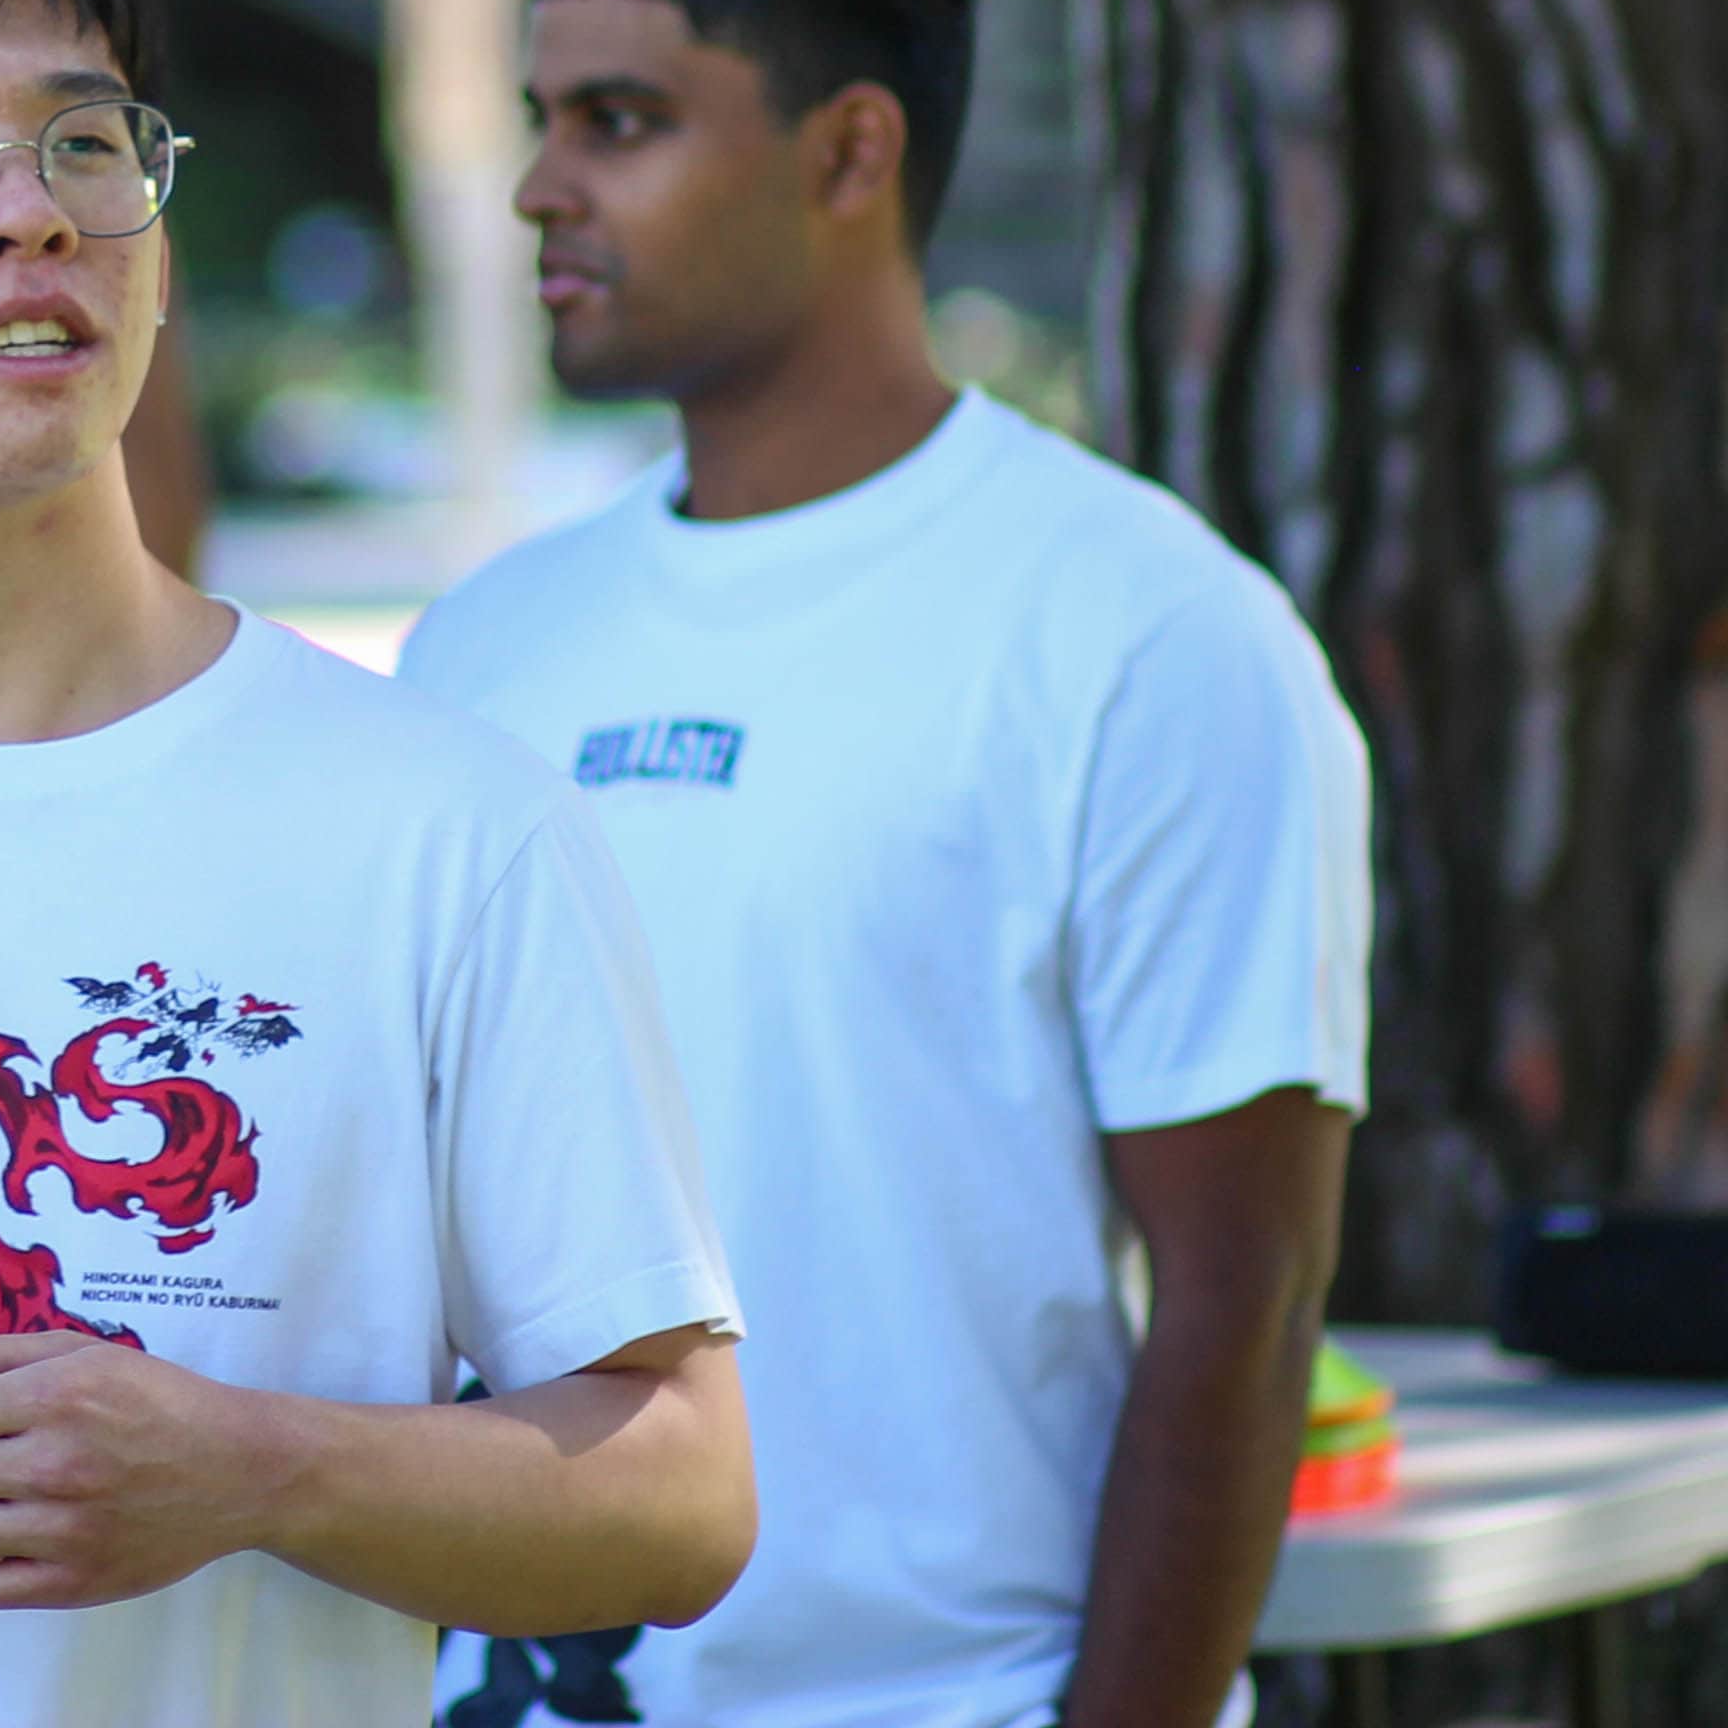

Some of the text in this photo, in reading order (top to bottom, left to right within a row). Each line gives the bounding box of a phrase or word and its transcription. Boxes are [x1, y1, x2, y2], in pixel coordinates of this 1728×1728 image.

[82, 1271, 224, 1290] HINOKAMI KAGURA
[80, 1289, 143, 1303] NICHIUN
[147, 1291, 169, 1305] NO
